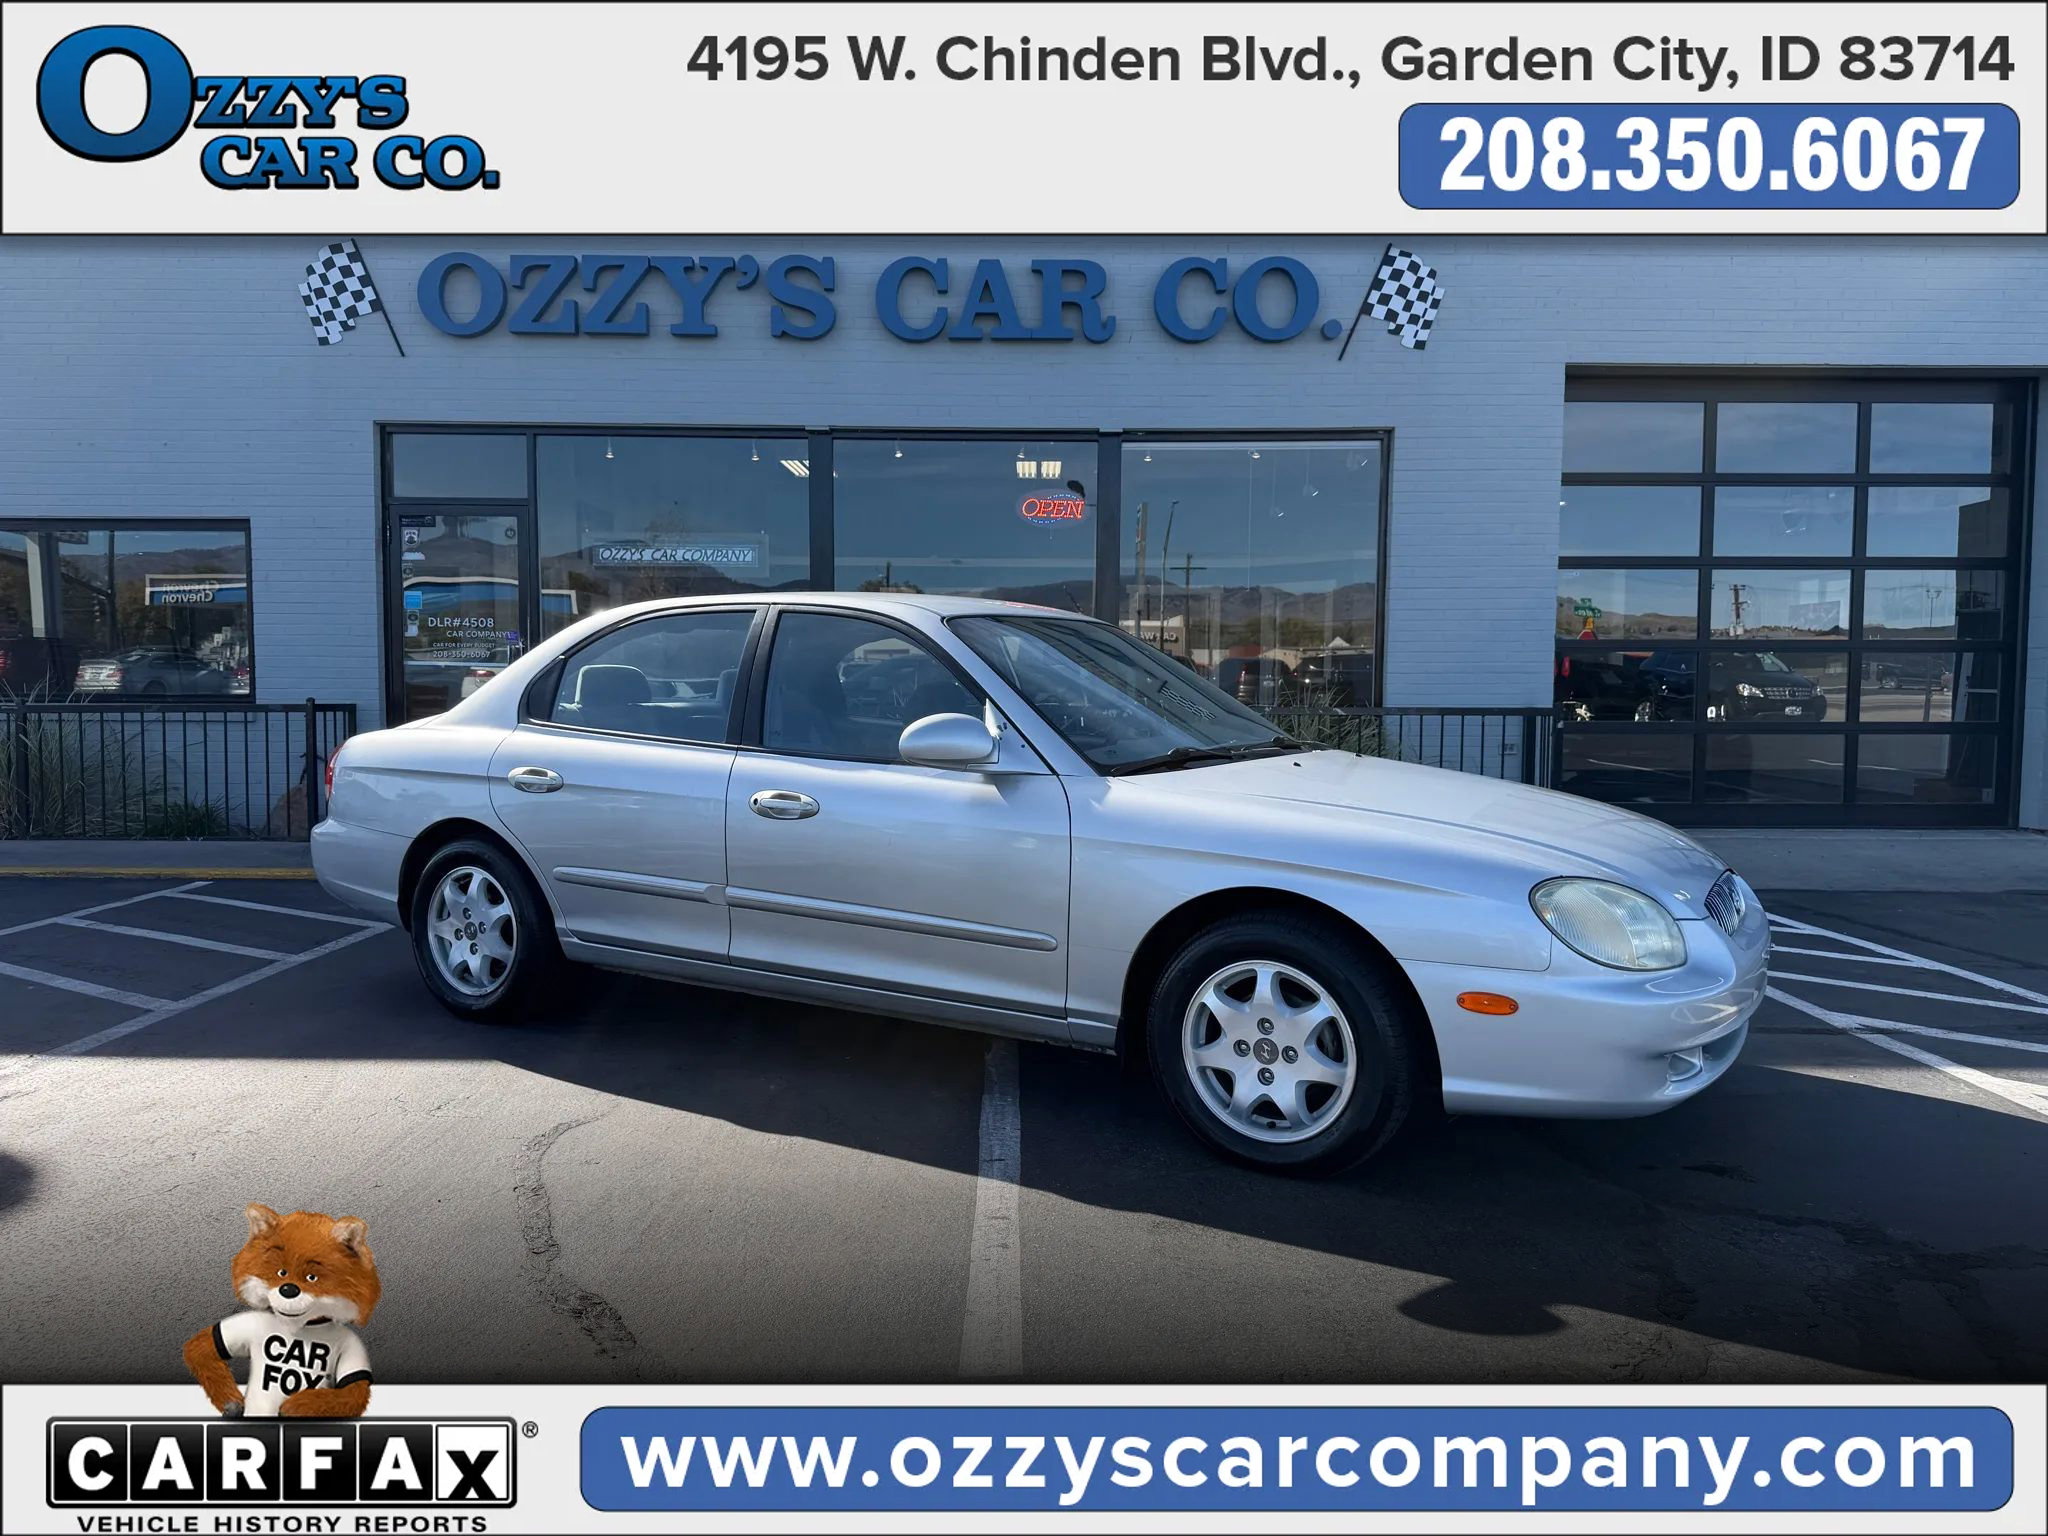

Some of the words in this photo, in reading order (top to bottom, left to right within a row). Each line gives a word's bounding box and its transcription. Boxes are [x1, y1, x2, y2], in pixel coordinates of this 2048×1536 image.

[416, 251, 836, 338] OZZY'S
[876, 255, 1117, 343] CAR
[1154, 255, 1343, 343] CO.
[1022, 498, 1084, 518] OPEN
[600, 547, 645, 560] OZZY'S
[651, 548, 678, 561] CAR
[682, 549, 751, 561] COMPANY
[428, 617, 494, 628] DLR#4508
